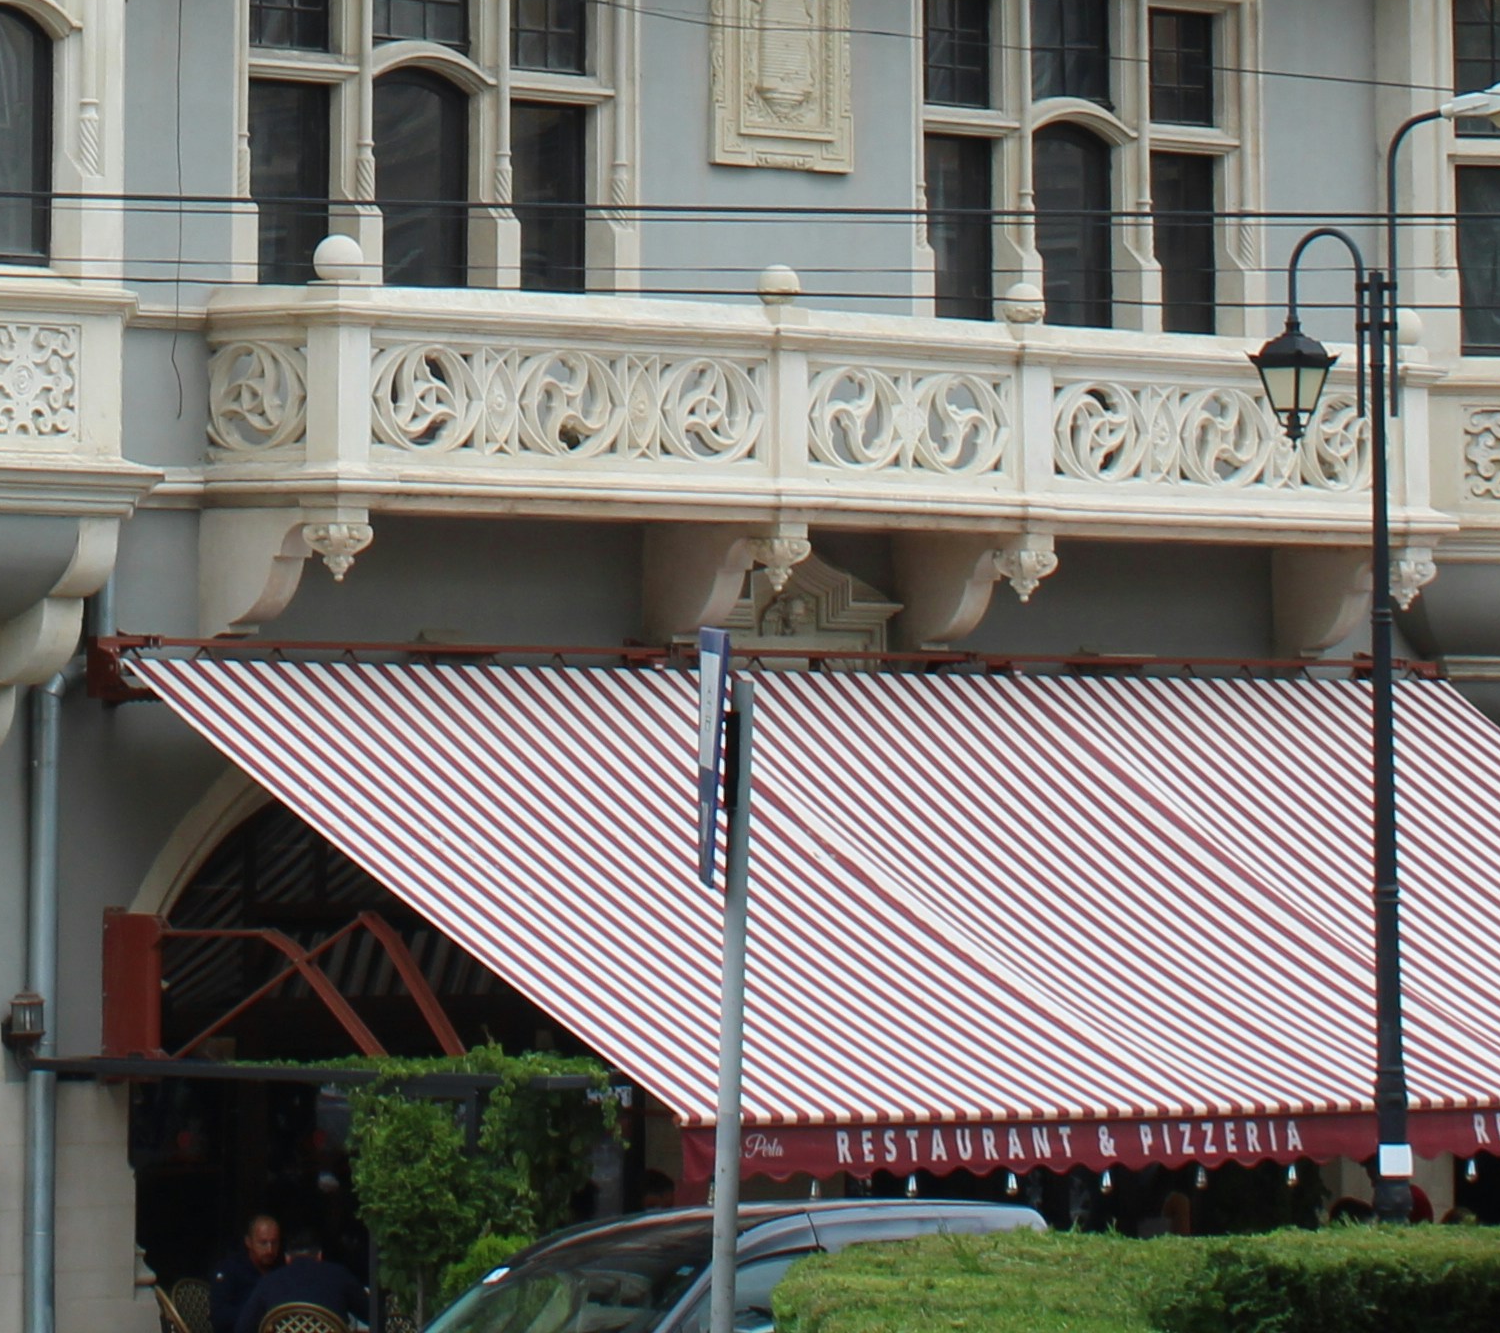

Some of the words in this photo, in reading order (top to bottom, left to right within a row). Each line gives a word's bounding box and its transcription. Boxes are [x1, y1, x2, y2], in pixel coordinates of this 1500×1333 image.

[745, 1134, 784, 1158] Perla
[836, 1125, 1072, 1164] RESTAURANT
[1098, 1125, 1117, 1157] &
[1139, 1120, 1303, 1156] PIZZERIA
